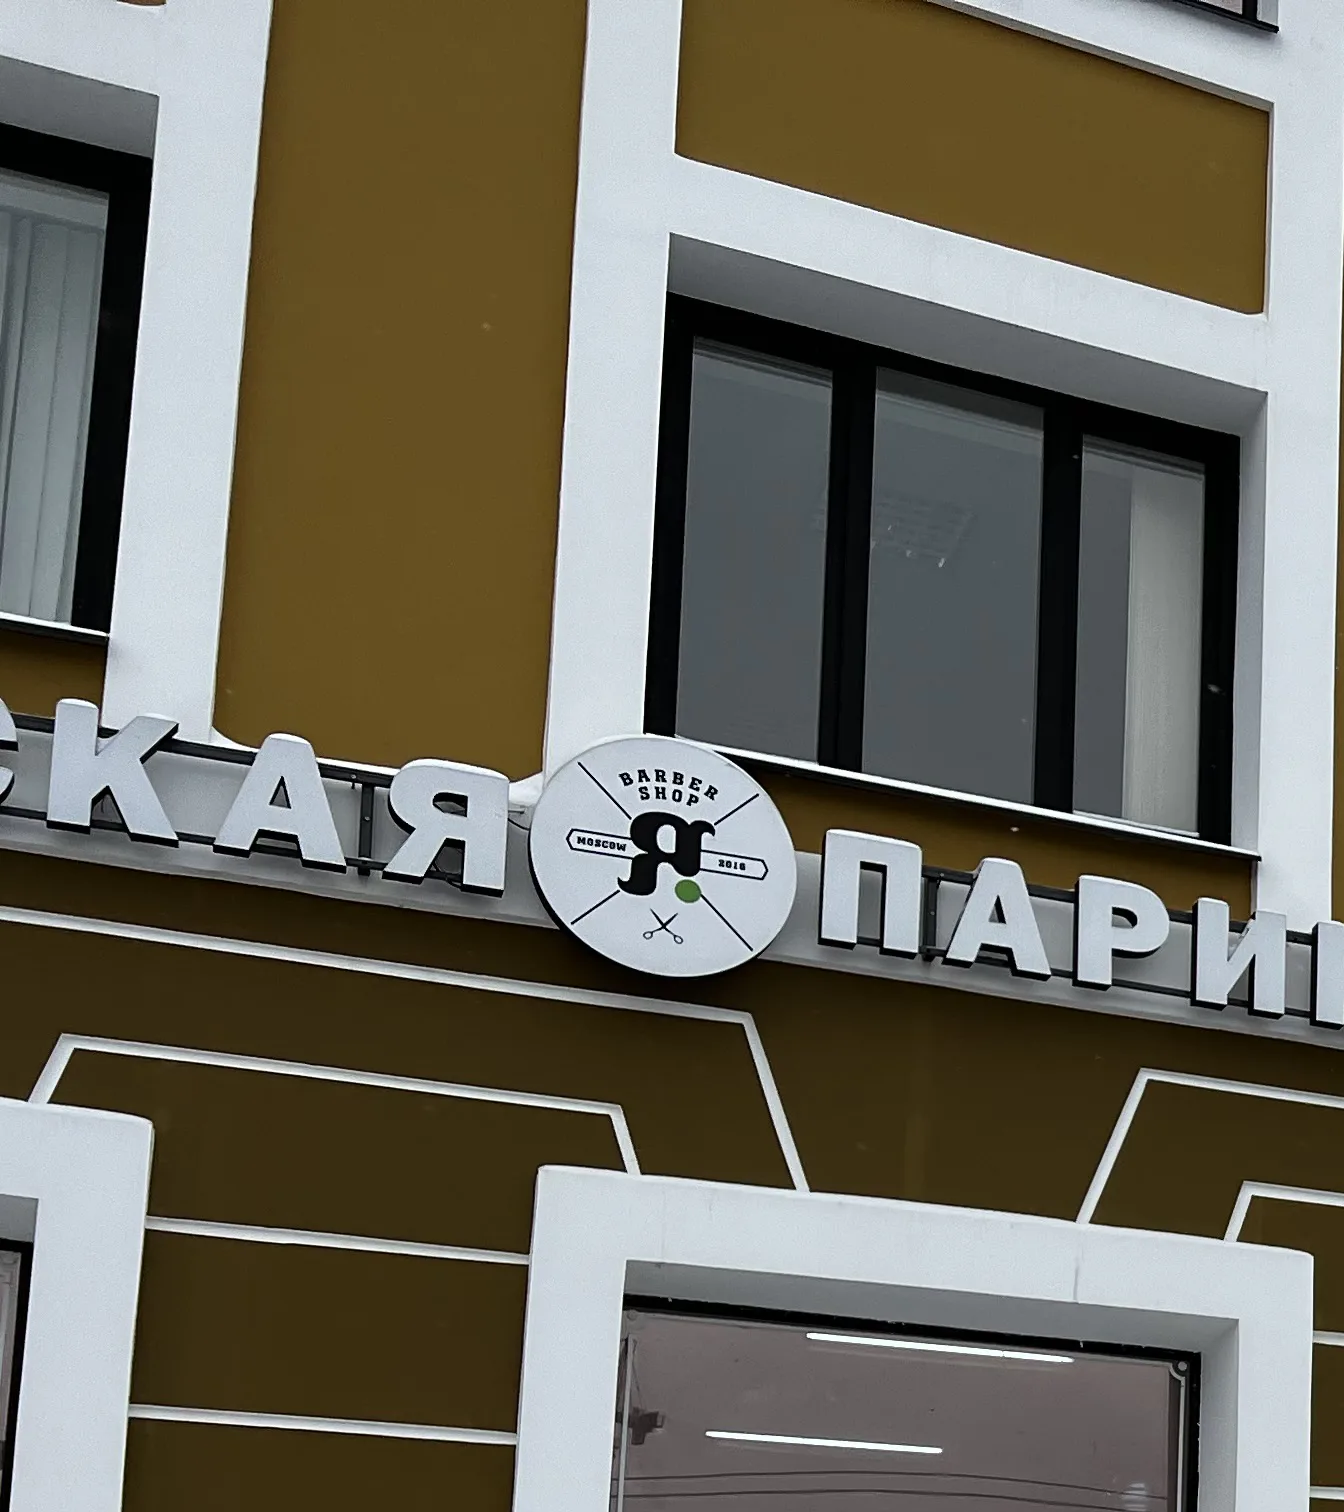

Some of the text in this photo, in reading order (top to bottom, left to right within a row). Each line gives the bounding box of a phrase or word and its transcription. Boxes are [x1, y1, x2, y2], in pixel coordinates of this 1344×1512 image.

[618, 769, 719, 800] BARBER
[638, 786, 699, 806] SHOP
[0, 697, 510, 898] КАЯ
[577, 836, 626, 851] MOSCOW
